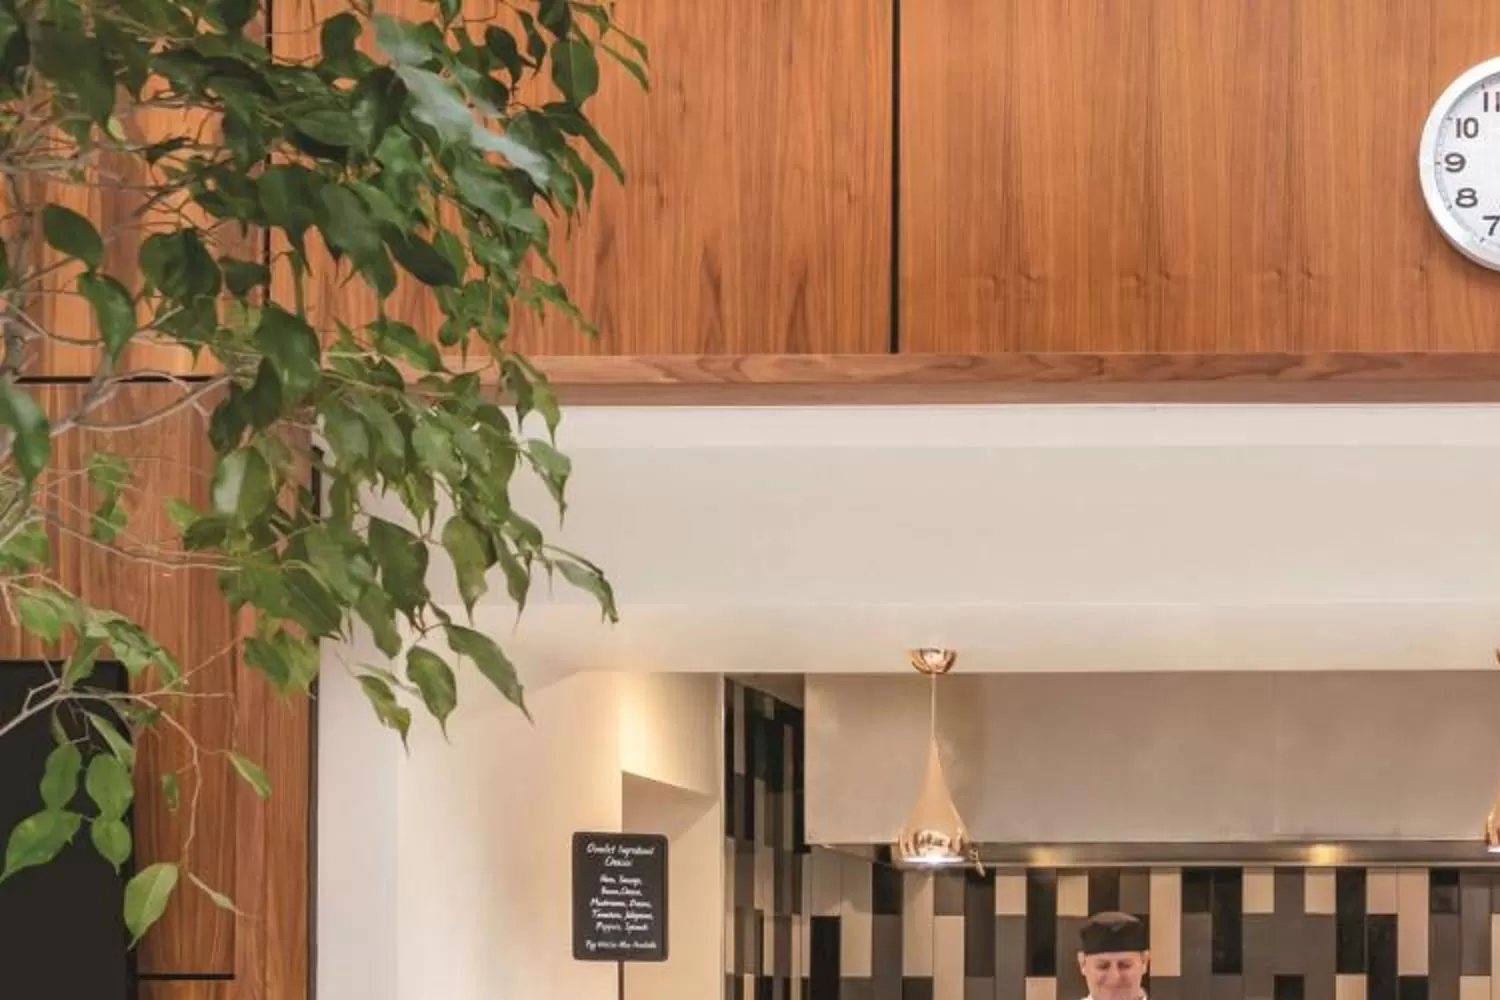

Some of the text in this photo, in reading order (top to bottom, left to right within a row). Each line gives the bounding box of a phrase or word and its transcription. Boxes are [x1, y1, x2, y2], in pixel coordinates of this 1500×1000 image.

[1483, 91, 1500, 113] 11
[1455, 117, 1479, 139] 10
[1444, 152, 1467, 173] 9
[1455, 187, 1478, 208] 8
[1482, 215, 1500, 237] 7
